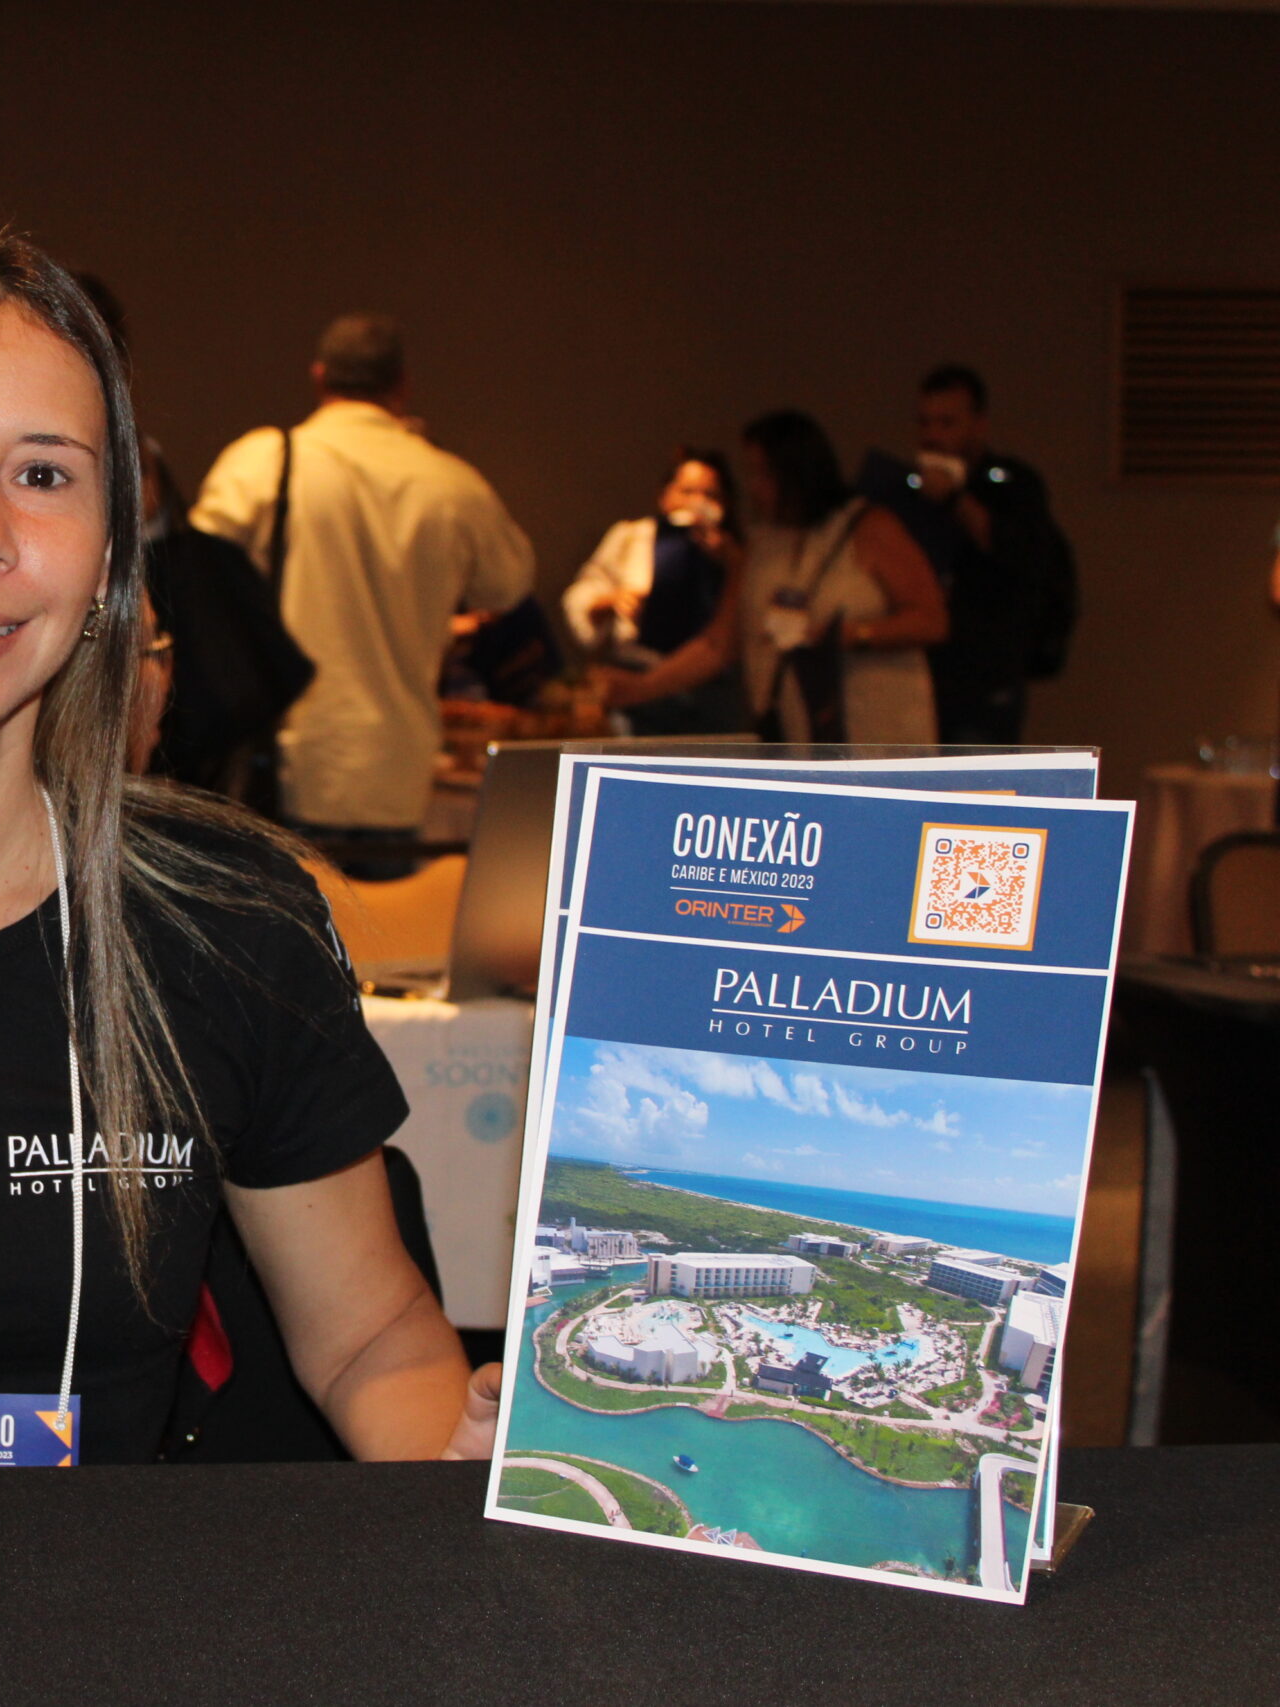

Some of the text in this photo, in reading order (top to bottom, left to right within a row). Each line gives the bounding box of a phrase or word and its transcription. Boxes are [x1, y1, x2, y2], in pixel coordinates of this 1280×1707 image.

[673, 812, 823, 867] CONEXÃO
[671, 864, 814, 890] CARIBE E MÉXICO 2023
[675, 899, 775, 922] ORINTER
[713, 968, 971, 1024] PALLADIUM
[709, 1019, 967, 1055] HOTEL GROUP
[10, 1177, 96, 1196] HOTL
